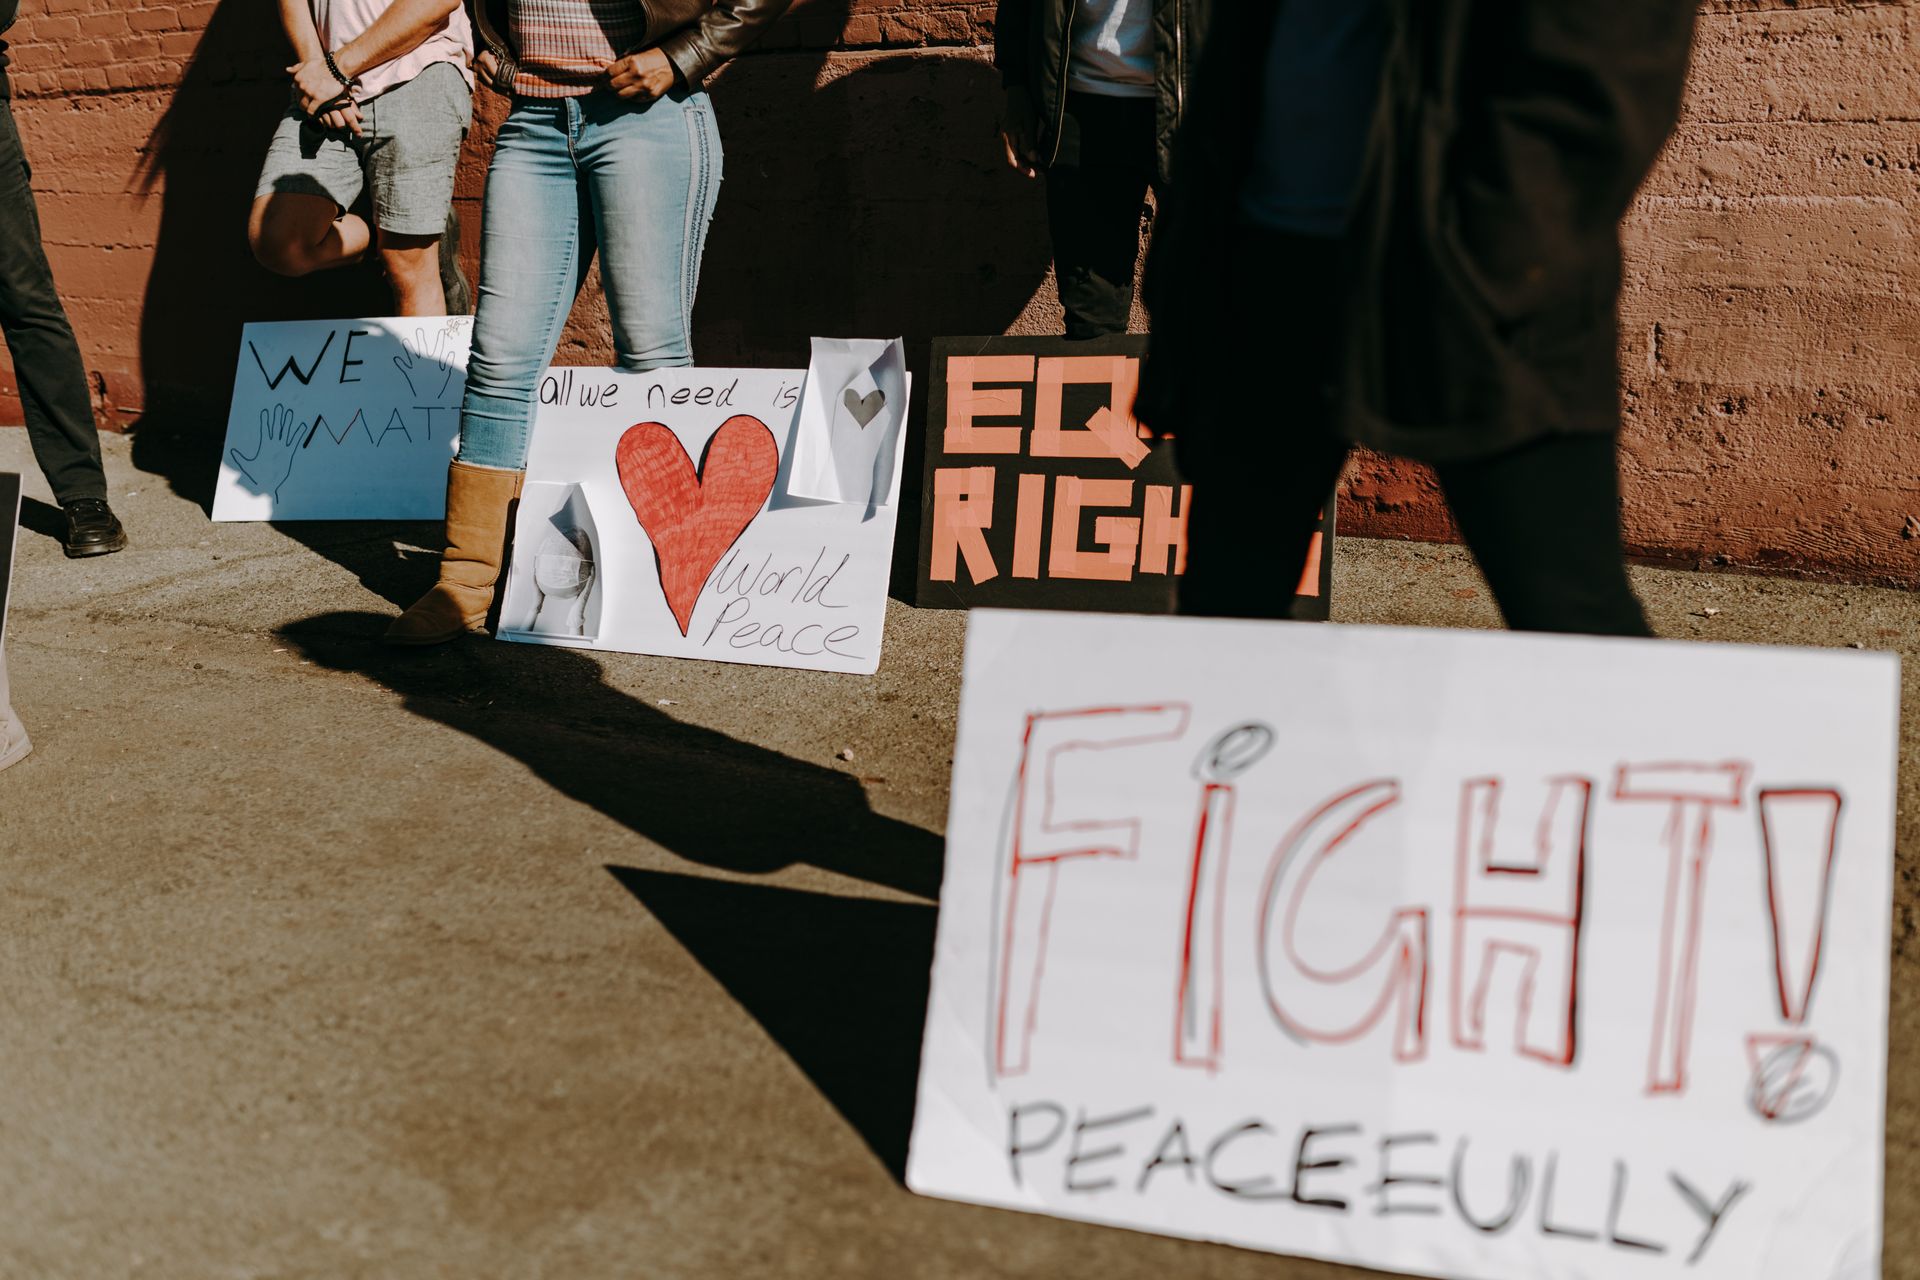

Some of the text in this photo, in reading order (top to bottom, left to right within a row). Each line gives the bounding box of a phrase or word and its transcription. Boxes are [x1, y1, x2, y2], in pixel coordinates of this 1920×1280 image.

[248, 330, 369, 390] WE
[539, 369, 799, 409] all we need is
[943, 355, 1176, 470] EQ
[930, 466, 1322, 598] RIGH
[709, 546, 851, 609] World
[702, 597, 866, 660] Peace
